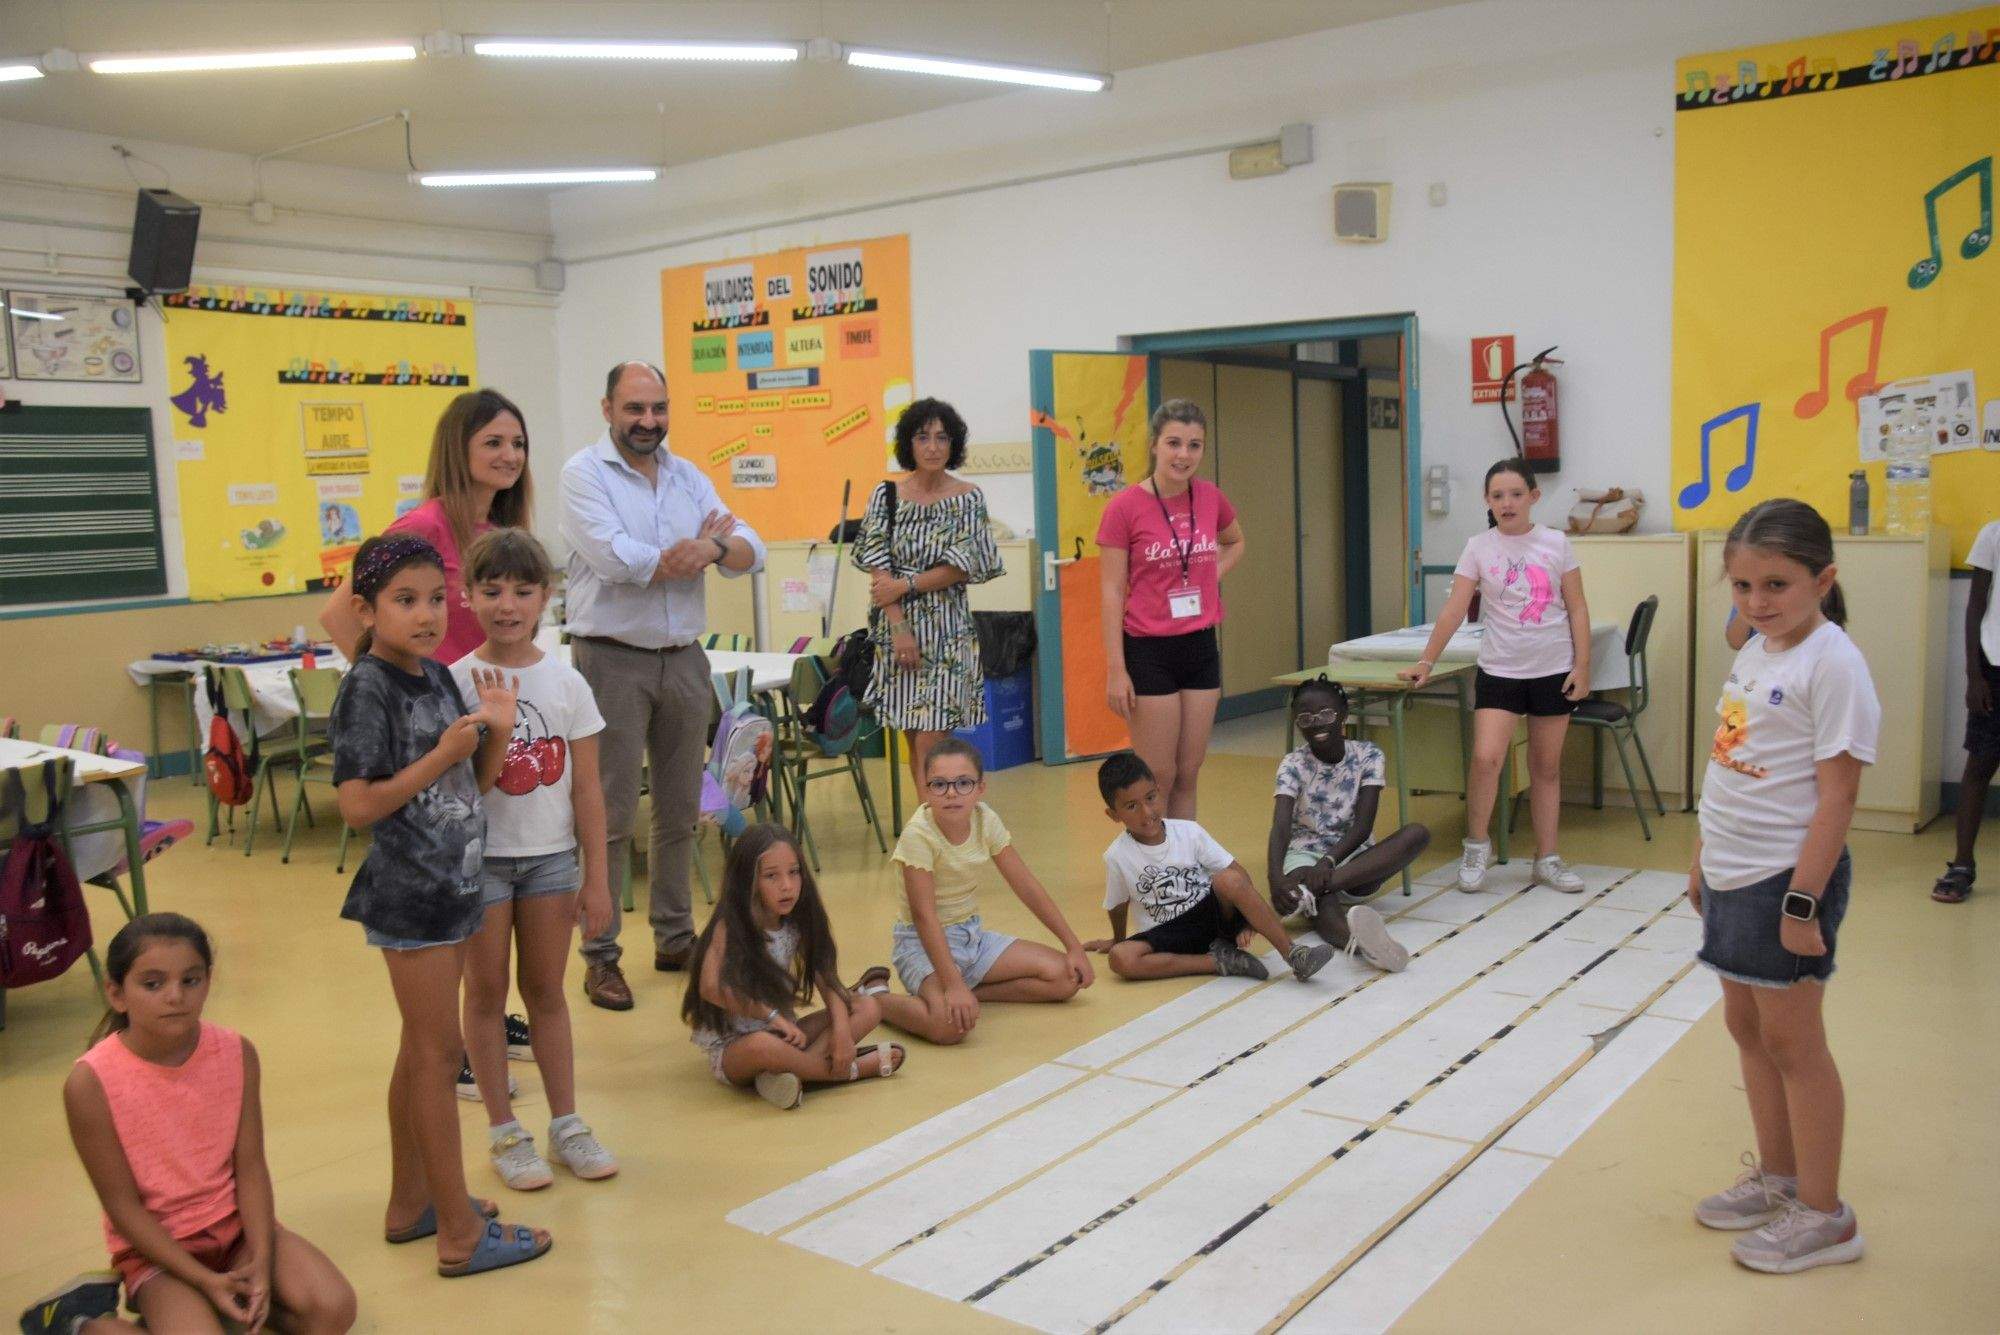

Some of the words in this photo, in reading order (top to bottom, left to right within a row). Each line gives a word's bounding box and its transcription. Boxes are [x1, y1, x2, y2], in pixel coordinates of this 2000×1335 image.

[705, 276, 754, 307] CUALIDADES
[768, 278, 790, 296] DEL
[809, 261, 862, 292] SONIDO
[790, 338, 822, 352] ALTURA
[311, 406, 355, 422] TEMPO
[321, 433, 352, 450] AIRE
